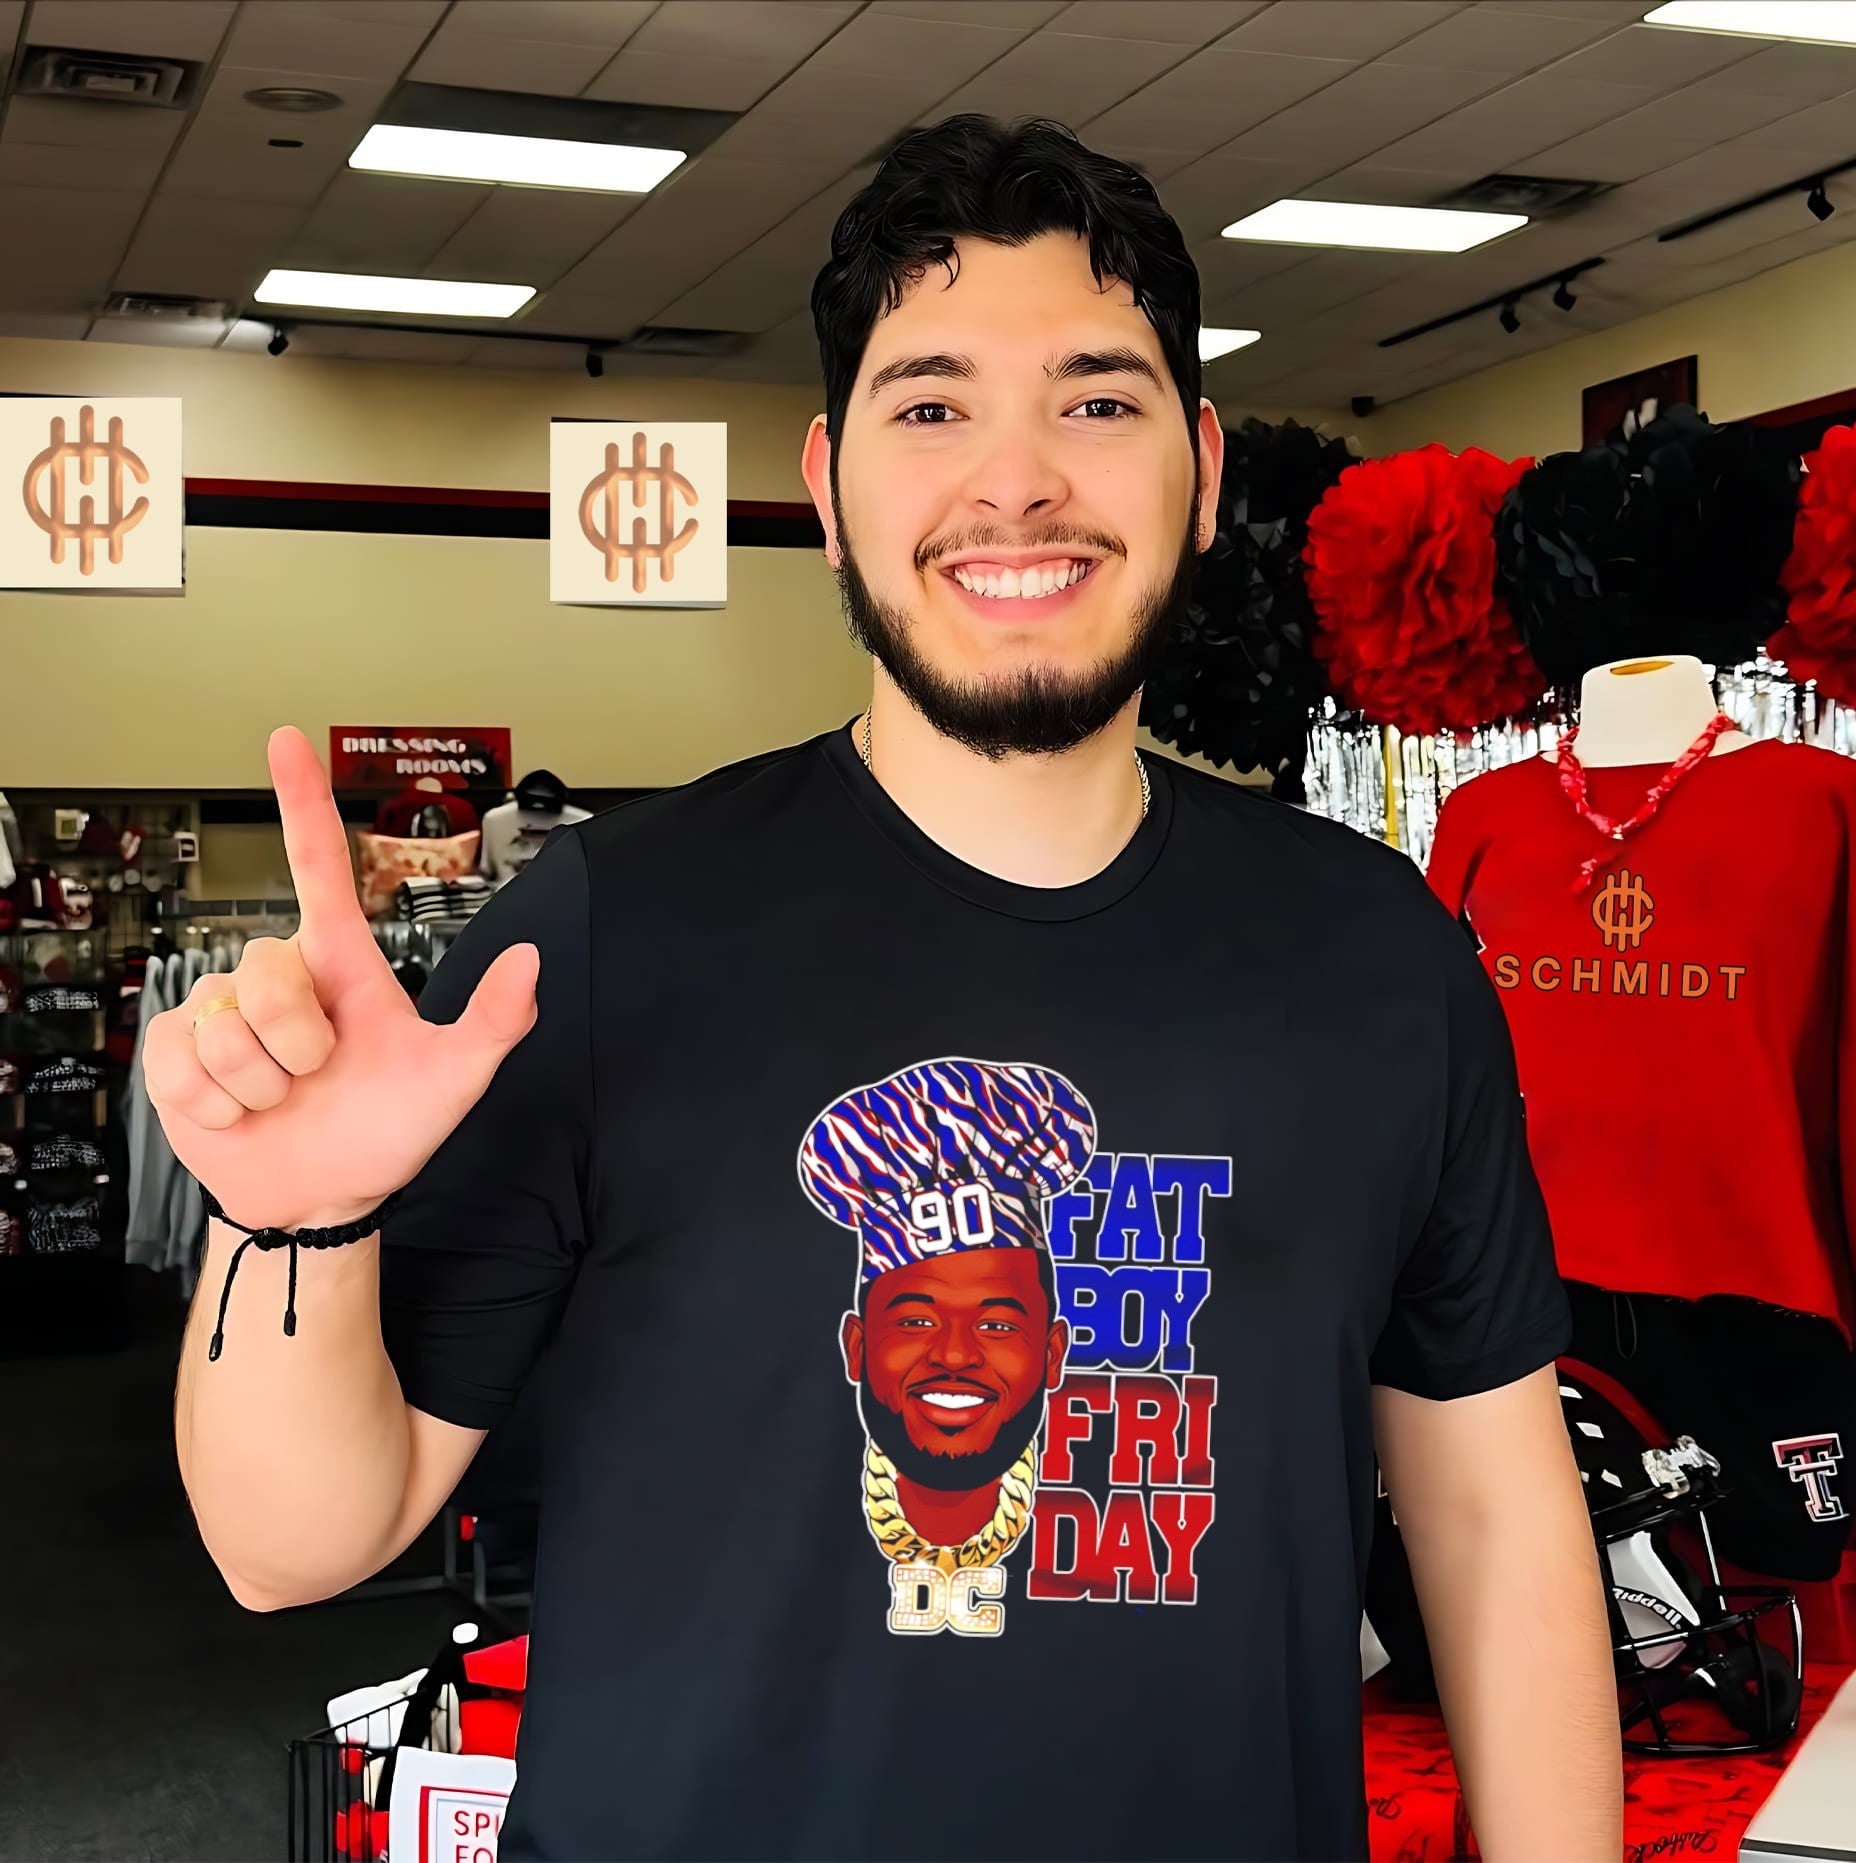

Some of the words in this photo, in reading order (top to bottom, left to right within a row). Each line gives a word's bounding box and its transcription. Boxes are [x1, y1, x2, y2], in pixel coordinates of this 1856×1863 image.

[342, 737, 467, 753] DRESSING
[396, 758, 487, 775] ROOMS
[1493, 953, 1747, 1000] SCHMIDT
[910, 1183, 995, 1253] 90
[1046, 1152, 1233, 1264] FAT
[1054, 1263, 1211, 1373] BOY
[1040, 1372, 1217, 1488] FRI
[1026, 1486, 1215, 1605] DAY
[887, 1563, 1007, 1638] DC
